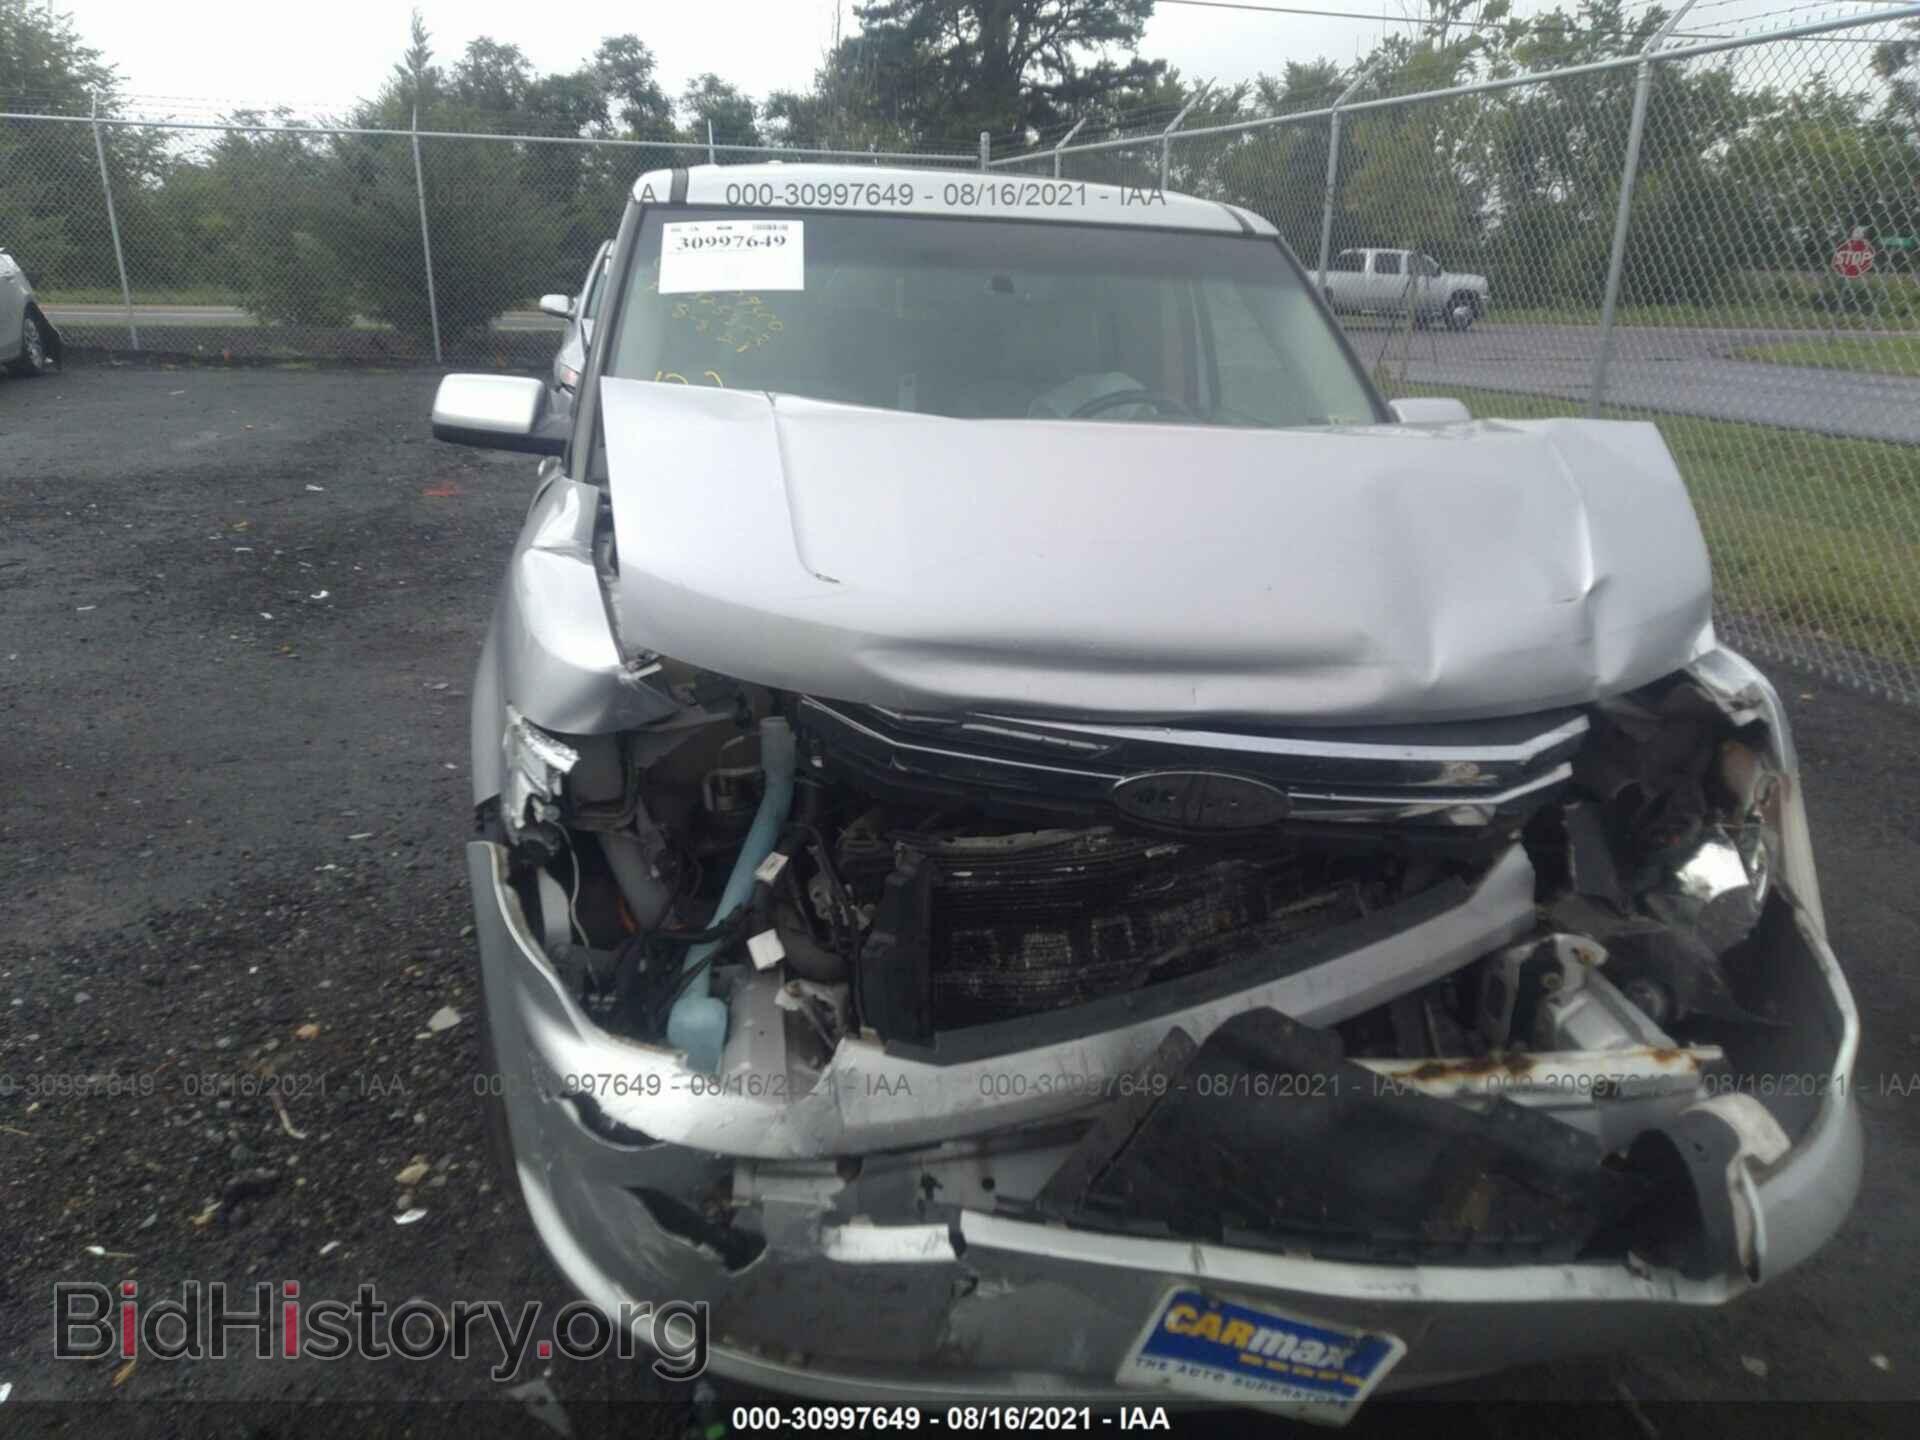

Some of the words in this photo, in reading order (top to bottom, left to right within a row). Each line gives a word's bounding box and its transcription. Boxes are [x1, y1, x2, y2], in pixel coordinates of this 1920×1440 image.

[676, 235, 786, 251] 30997649
[1835, 251, 1875, 265] STOP
[1135, 1358, 1168, 1371] THE
[1177, 1364, 1226, 1382] AUTO
